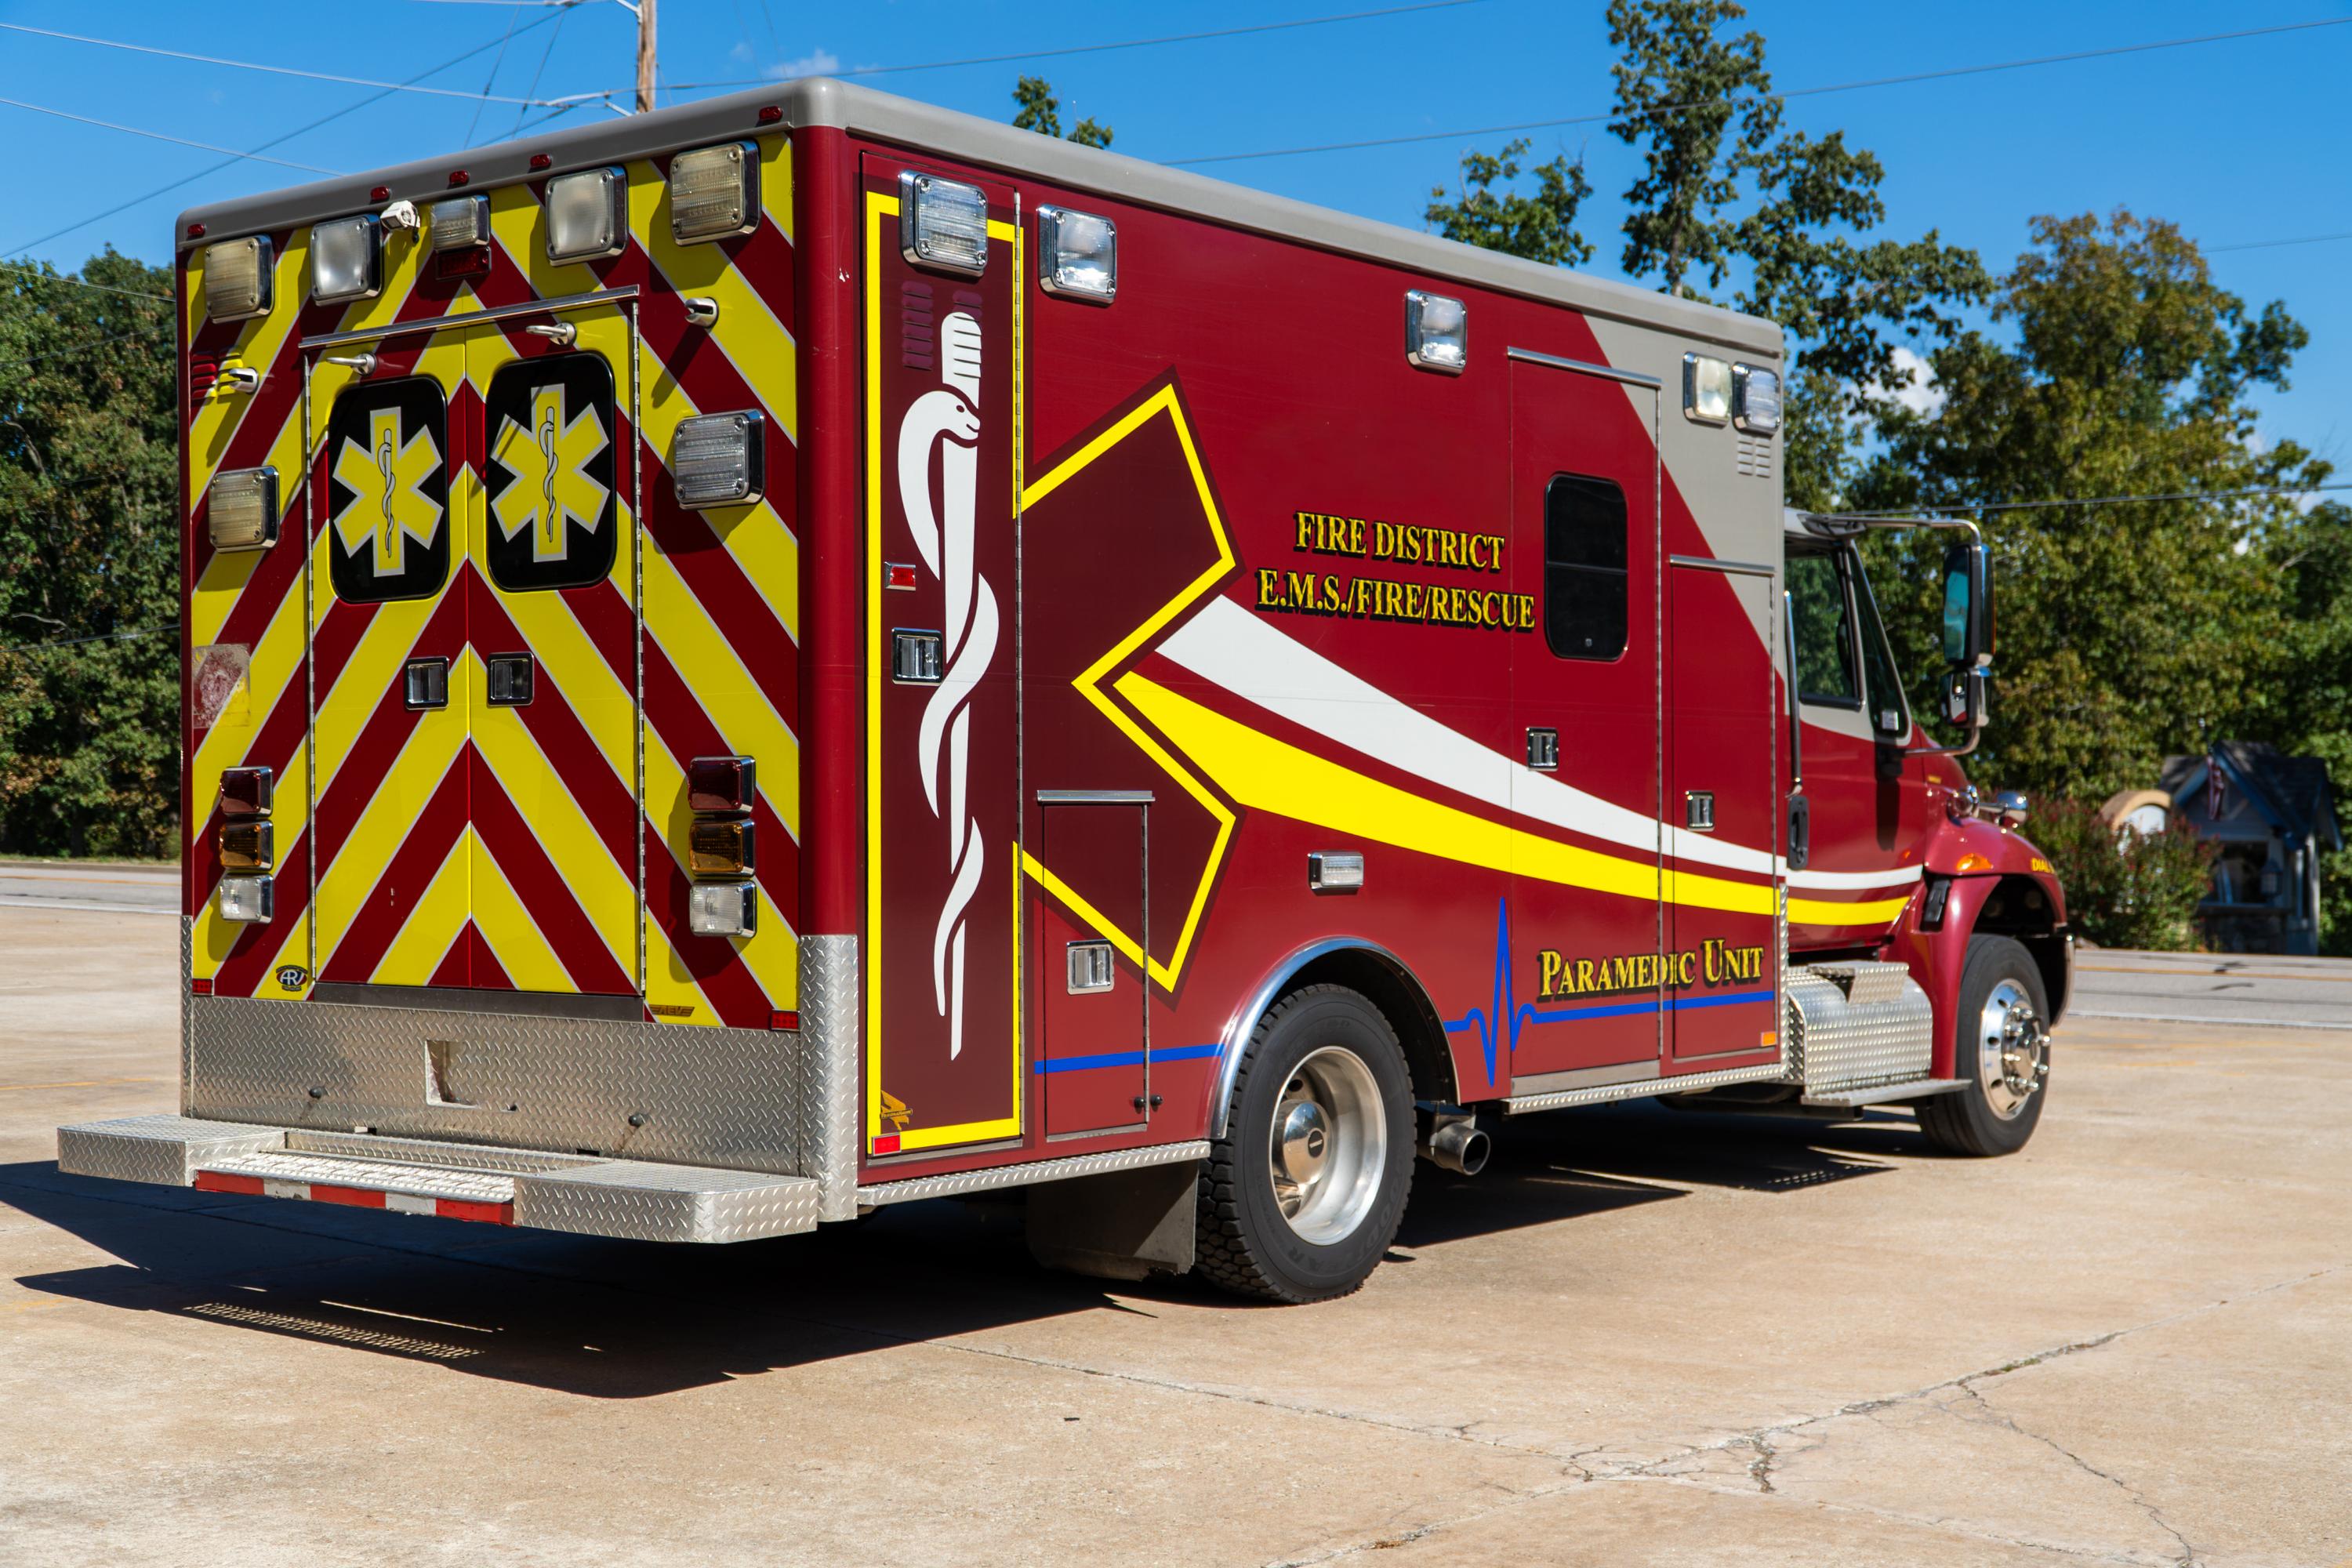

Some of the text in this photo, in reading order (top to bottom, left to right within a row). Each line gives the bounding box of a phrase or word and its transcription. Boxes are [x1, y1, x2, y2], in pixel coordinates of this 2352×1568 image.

[1294, 511, 1504, 572] FIRE DISTRICT
[1257, 568, 1536, 630] E.M.S./FIRE/RESCUE
[1538, 938, 1764, 999] PARAMEDIC UNIT
